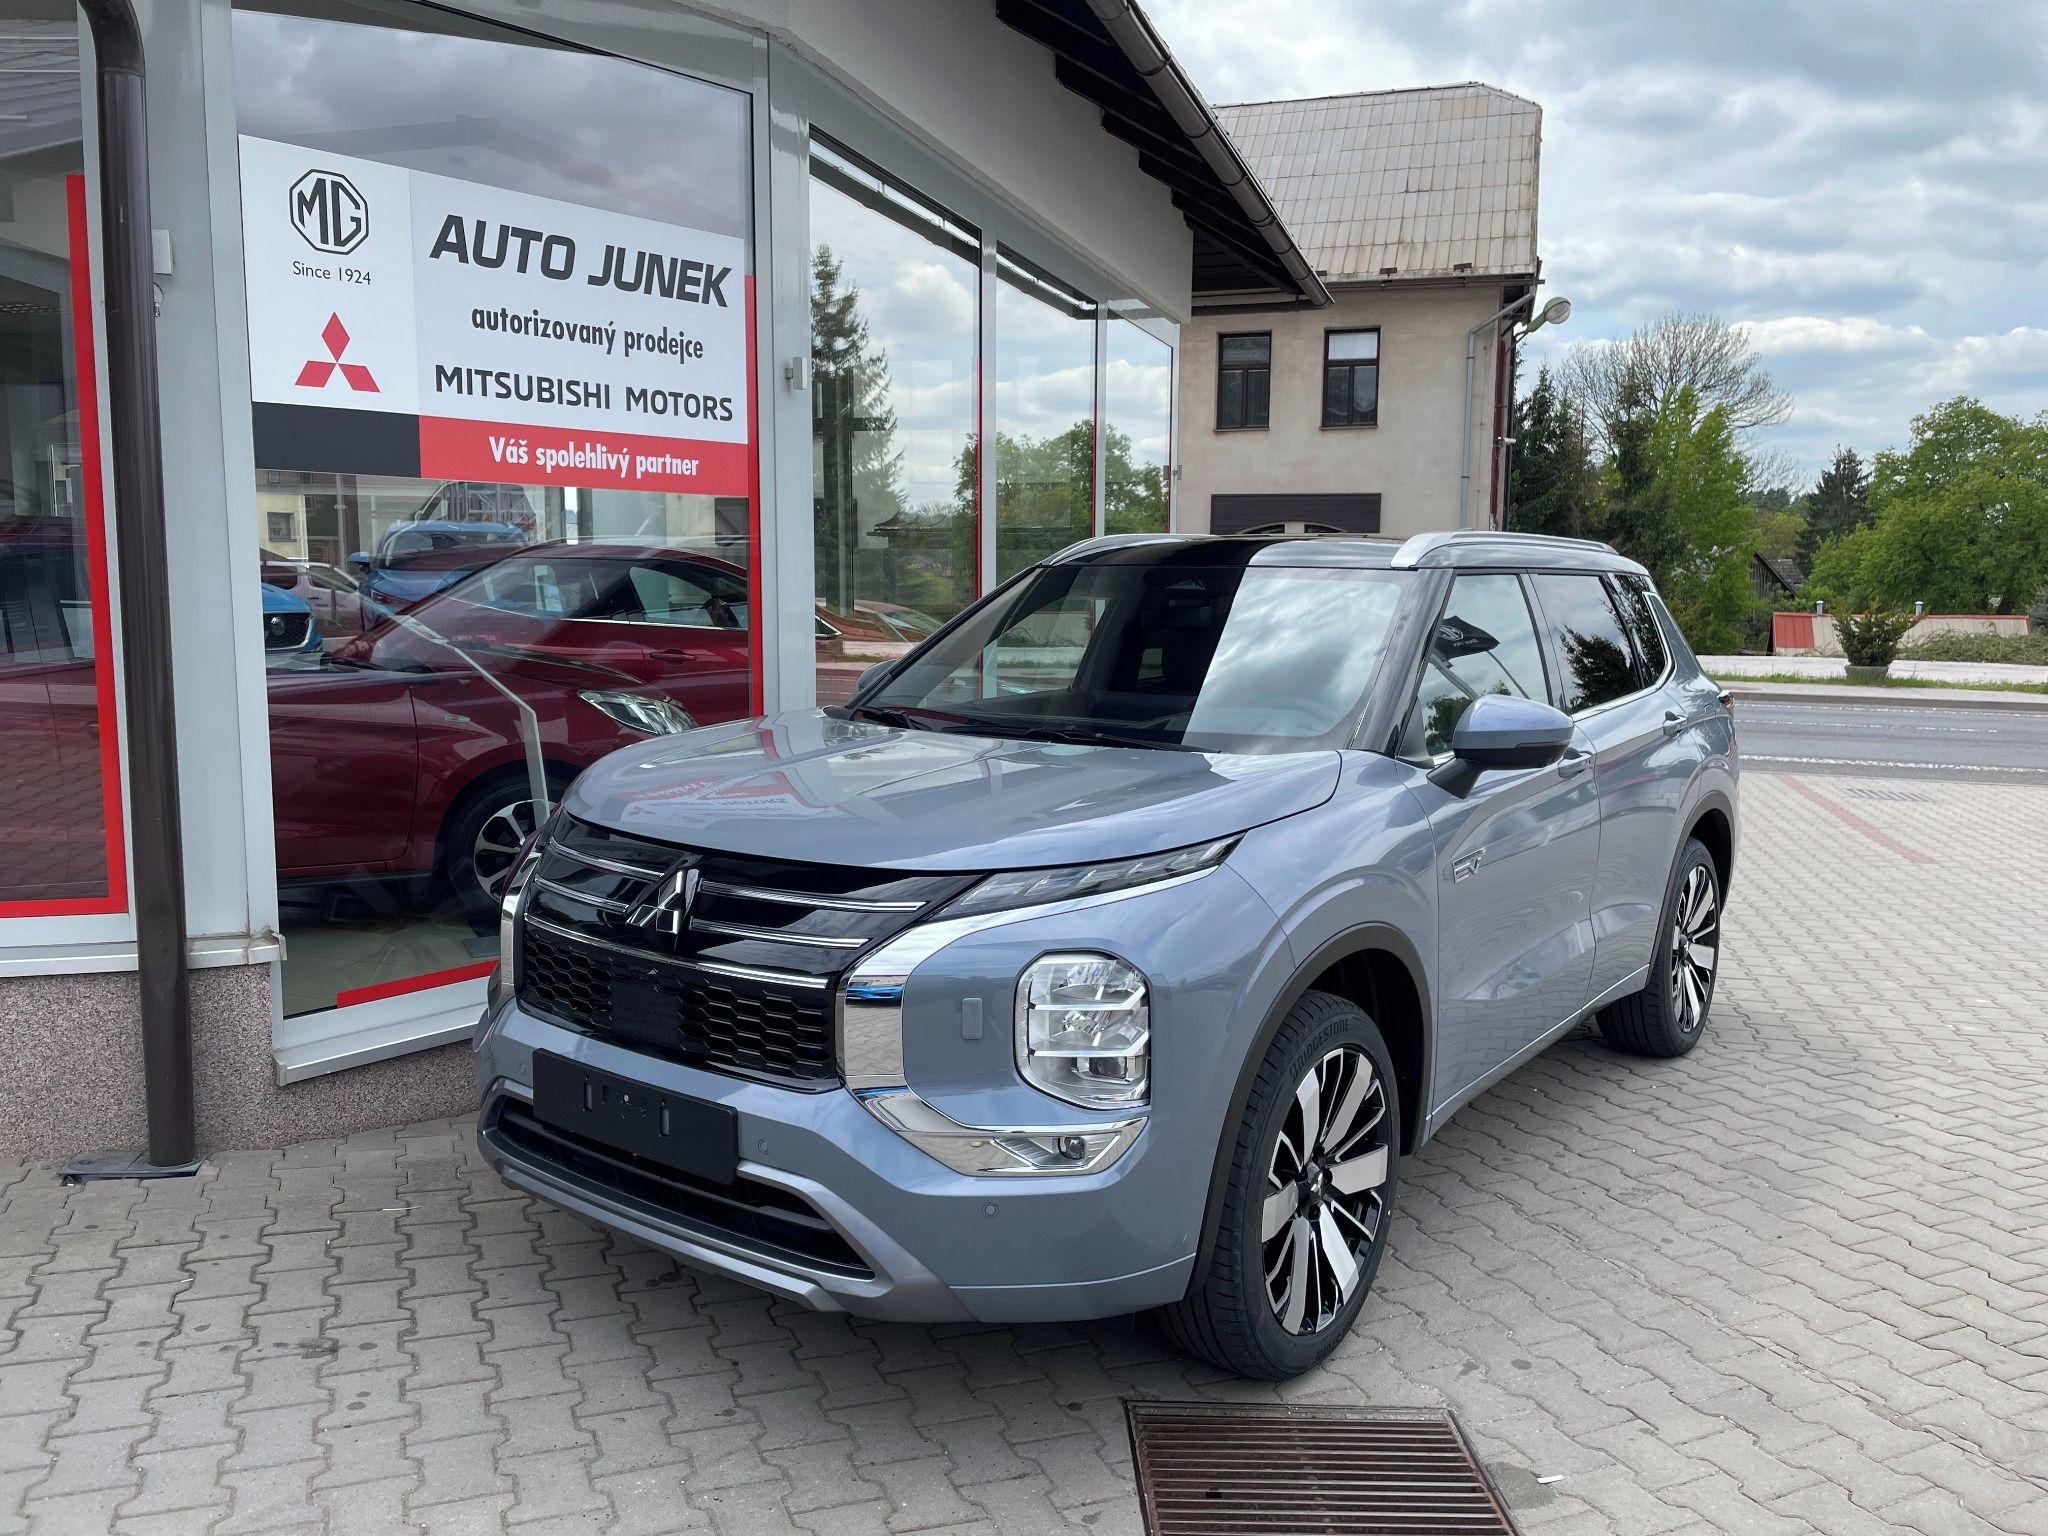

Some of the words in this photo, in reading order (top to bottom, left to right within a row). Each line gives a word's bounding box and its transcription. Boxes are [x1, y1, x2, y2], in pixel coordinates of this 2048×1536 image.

[298, 177, 362, 248] MG
[292, 260, 331, 280] Since
[338, 267, 372, 286] 1924
[429, 214, 576, 281] AUTO
[587, 244, 732, 308] JUNEK
[472, 308, 617, 355] autorizovaný
[623, 330, 704, 365] prodejce
[435, 364, 612, 410] MITSUBISHI
[626, 386, 733, 422] MOTORS
[488, 436, 529, 465] Váš
[535, 442, 630, 479] spolehlivý
[635, 453, 700, 480] partner
[1290, 1018, 1350, 1081] BRIDGESTONE
